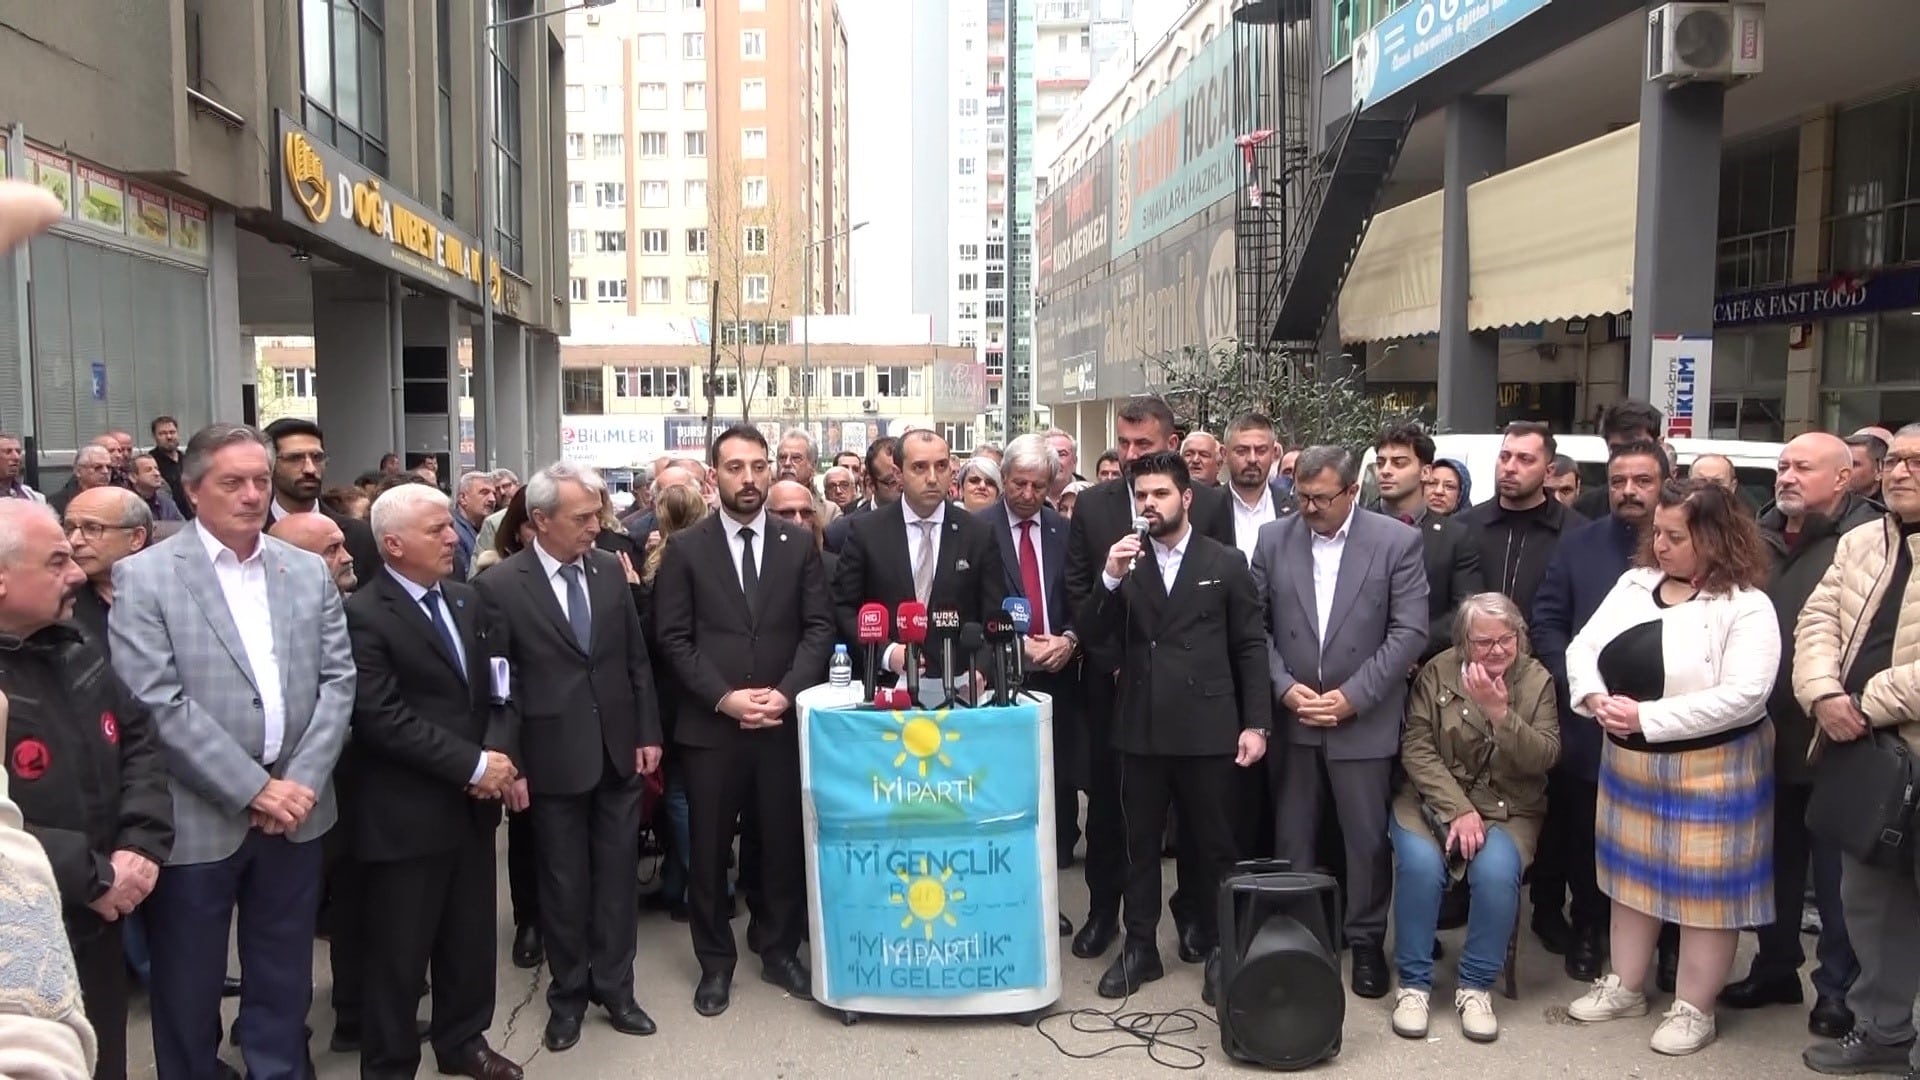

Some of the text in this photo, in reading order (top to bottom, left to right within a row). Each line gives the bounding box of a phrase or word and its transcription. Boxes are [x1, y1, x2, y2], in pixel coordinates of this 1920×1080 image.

[1142, 184, 1188, 229] SINAVLARA
[1188, 152, 1234, 205] HAZIRLIK
[338, 172, 437, 261] DOĞANBEY
[436, 230, 482, 286] EMLAK
[1053, 239, 1072, 273] KURS
[1072, 205, 1108, 267] MERKEZİ
[1104, 251, 1200, 366] akademik
[1713, 286, 1867, 323] CAFE & FAST FOOD
[873, 775, 974, 804] İYİ PARTİ
[845, 840, 1012, 882] İYİ GENÇLİK
